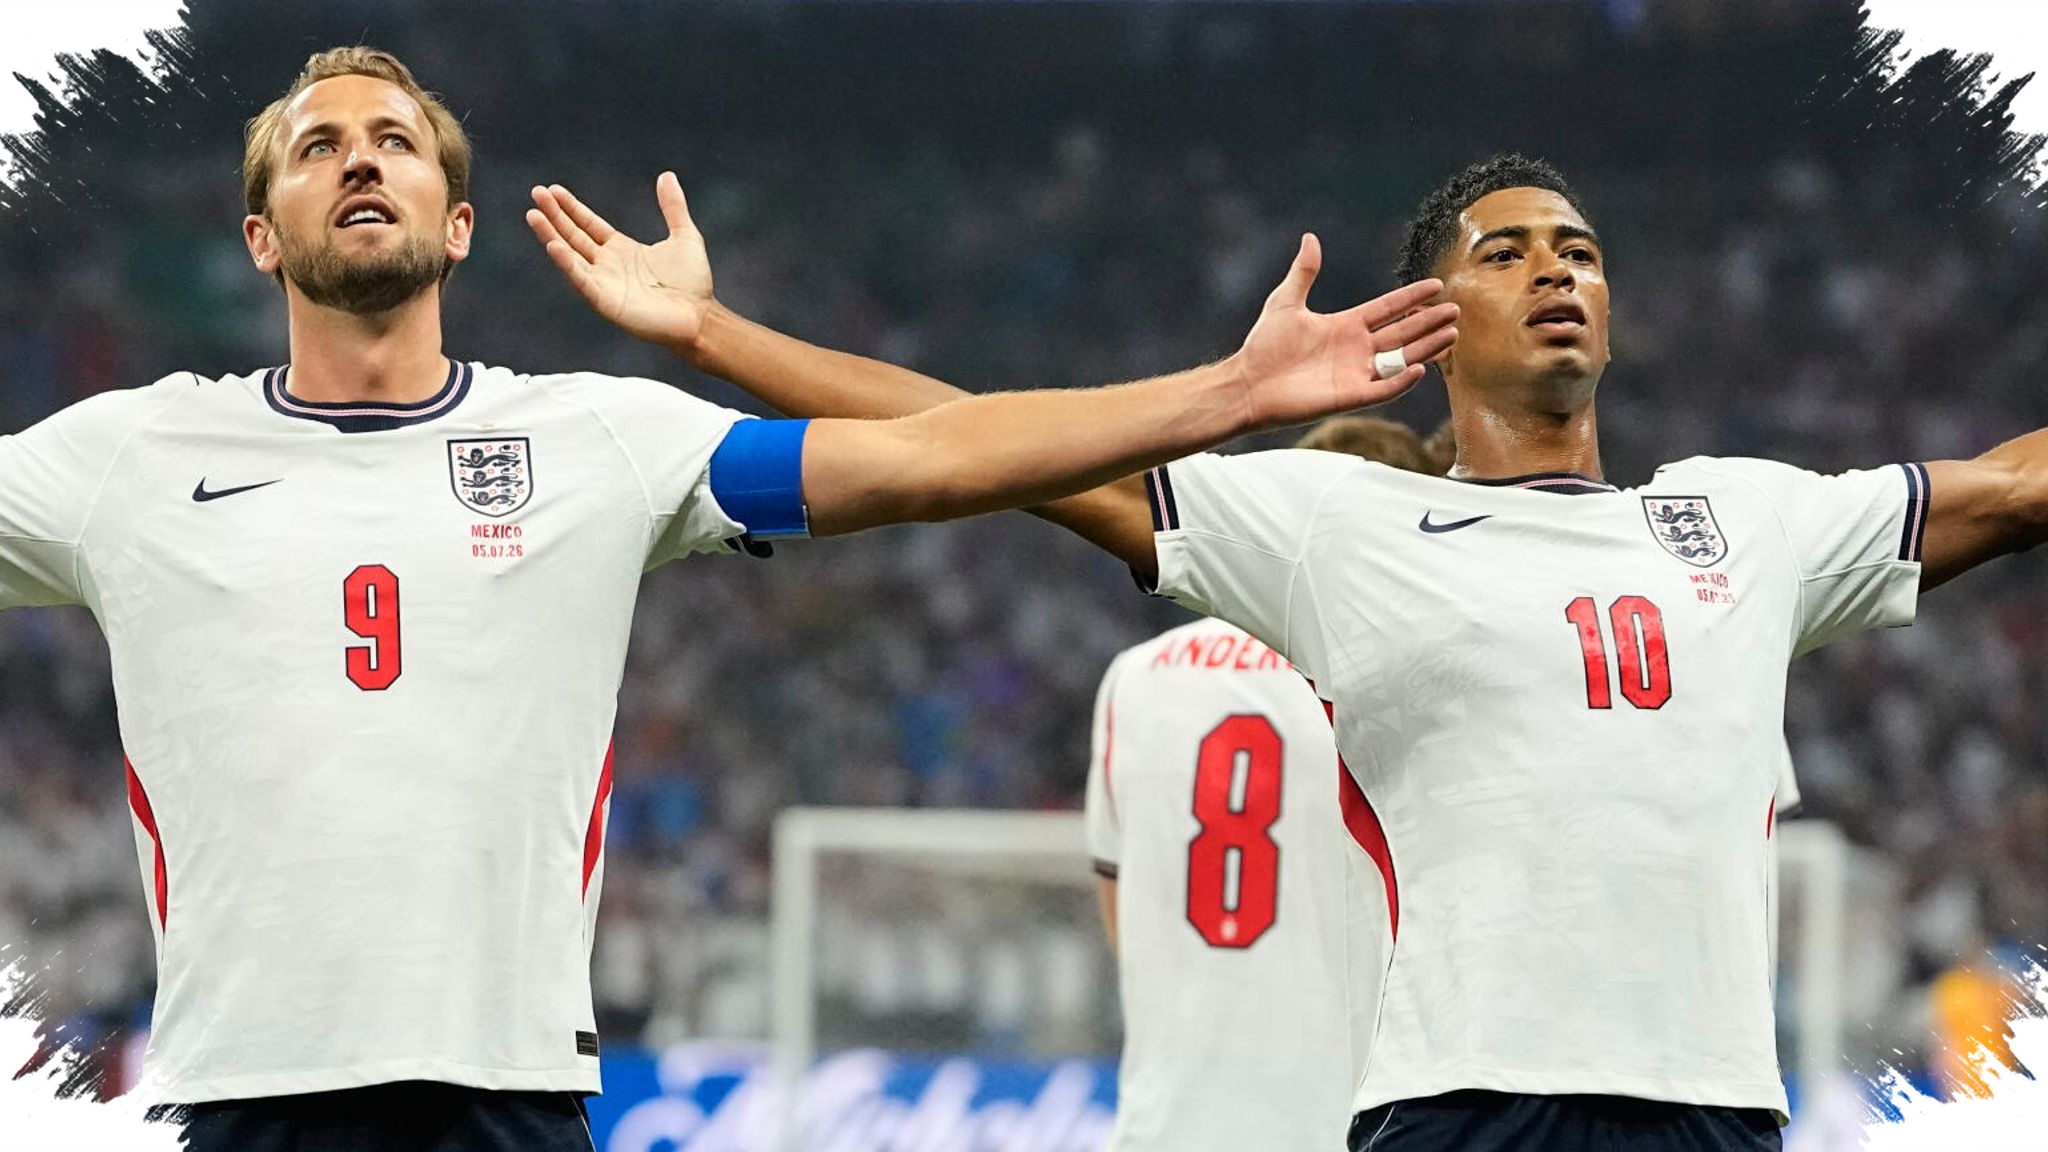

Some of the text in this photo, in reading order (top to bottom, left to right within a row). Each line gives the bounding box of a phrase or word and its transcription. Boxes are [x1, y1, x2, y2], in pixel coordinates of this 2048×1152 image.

[471, 524, 522, 539] MEXICO
[472, 544, 523, 558] 05.07.26
[343, 564, 402, 691] 9
[1151, 635, 1295, 669] ANDER
[1565, 595, 1672, 710] 10
[1186, 714, 1284, 949] 8
